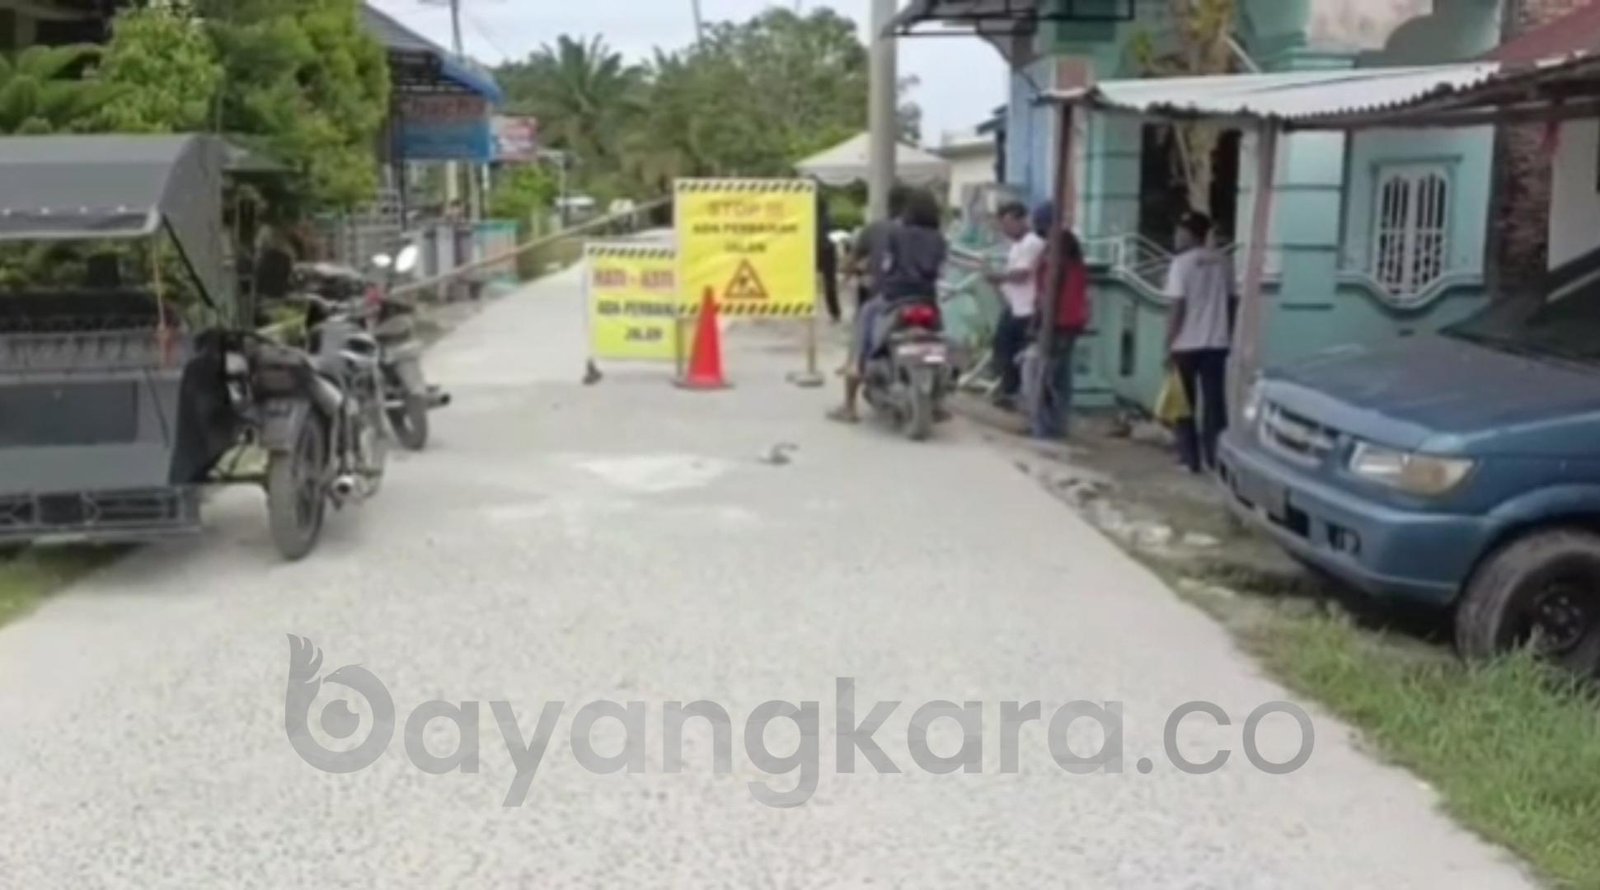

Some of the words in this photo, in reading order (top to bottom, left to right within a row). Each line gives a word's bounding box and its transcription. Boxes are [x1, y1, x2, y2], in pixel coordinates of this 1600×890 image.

[707, 200, 761, 216] STOP
[693, 223, 720, 234] ADA
[724, 241, 767, 253] JALAN
[594, 268, 626, 288] HATI
[598, 300, 621, 315] ADA
